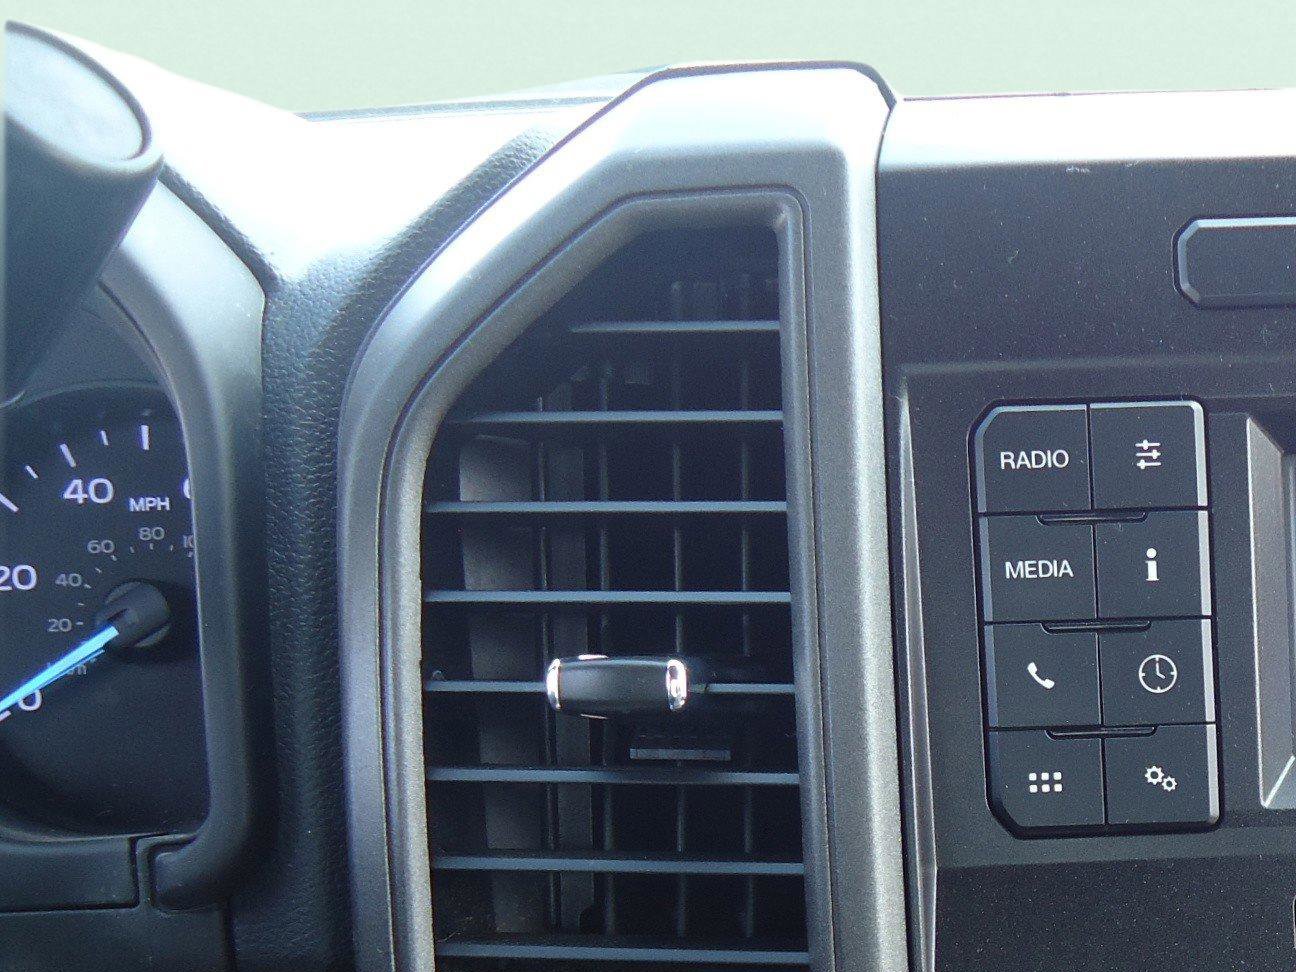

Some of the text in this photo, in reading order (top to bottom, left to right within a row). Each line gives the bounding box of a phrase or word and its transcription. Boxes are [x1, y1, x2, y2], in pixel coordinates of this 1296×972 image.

[1000, 449, 1070, 470] RADIO
[63, 477, 114, 504] 40
[128, 496, 170, 512] MPH
[139, 526, 165, 541] 80
[86, 539, 115, 554] 60
[1005, 559, 1075, 579] MEDIA
[0, 564, 37, 591] 20
[54, 573, 82, 587] 40
[48, 618, 72, 634] 20
